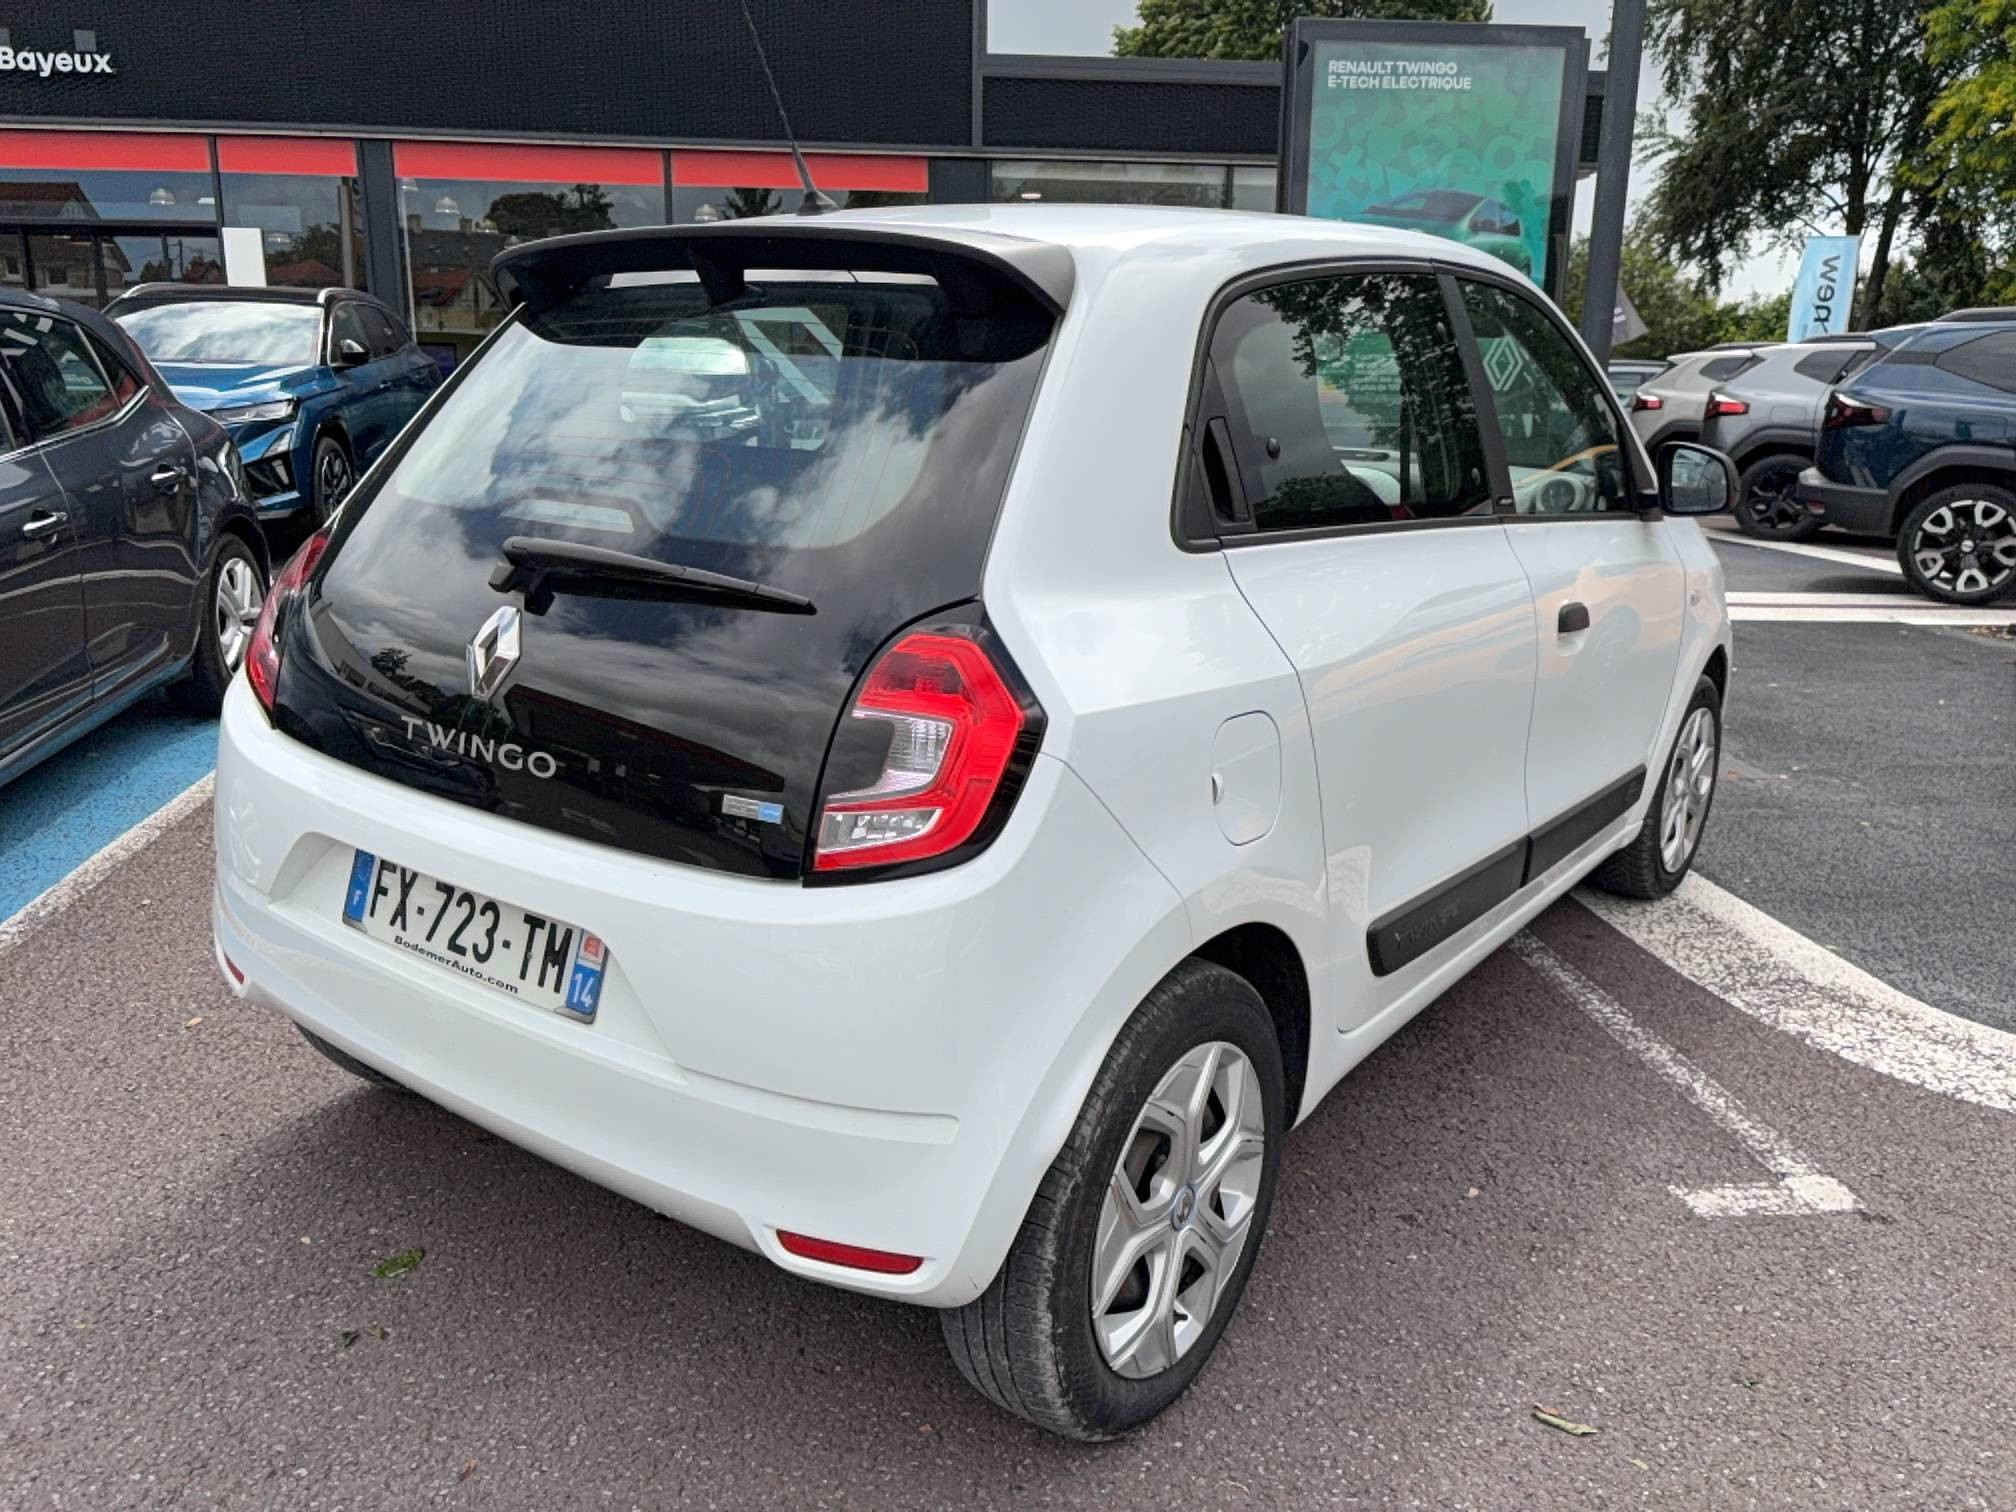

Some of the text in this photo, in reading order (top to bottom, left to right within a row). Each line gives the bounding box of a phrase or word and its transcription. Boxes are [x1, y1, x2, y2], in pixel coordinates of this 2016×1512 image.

[0, 46, 113, 77] Bayeux
[1328, 60, 1457, 75] RENAULT TWINGO
[1327, 75, 1471, 90] E-TECH ELECTRIQUE
[401, 715, 557, 778] TWINGO
[369, 859, 573, 994] FX-723-TM
[394, 935, 519, 995] BodemerAuto.com
[573, 973, 595, 1008] 14
